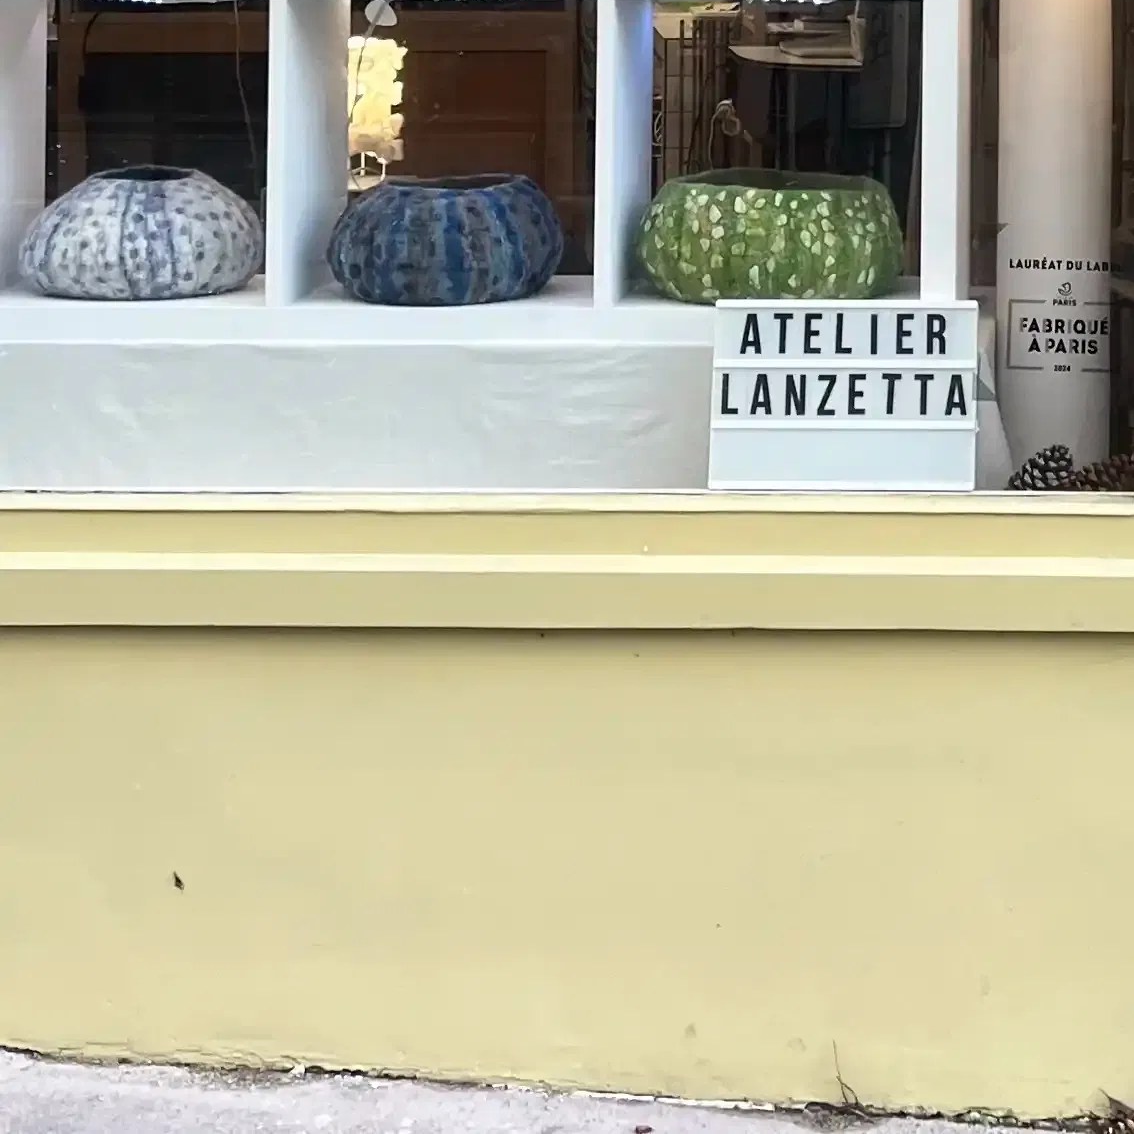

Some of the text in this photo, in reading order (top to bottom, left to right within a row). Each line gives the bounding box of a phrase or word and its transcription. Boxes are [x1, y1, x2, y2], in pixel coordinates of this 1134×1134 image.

[1009, 257, 1063, 271] LAURÉAT
[1066, 260, 1083, 271] DU
[739, 313, 947, 356] ATELIER
[1020, 316, 1109, 336] FABRIQUÉ
[1028, 333, 1099, 355] À PARIS
[720, 372, 968, 417] LANZETTA
